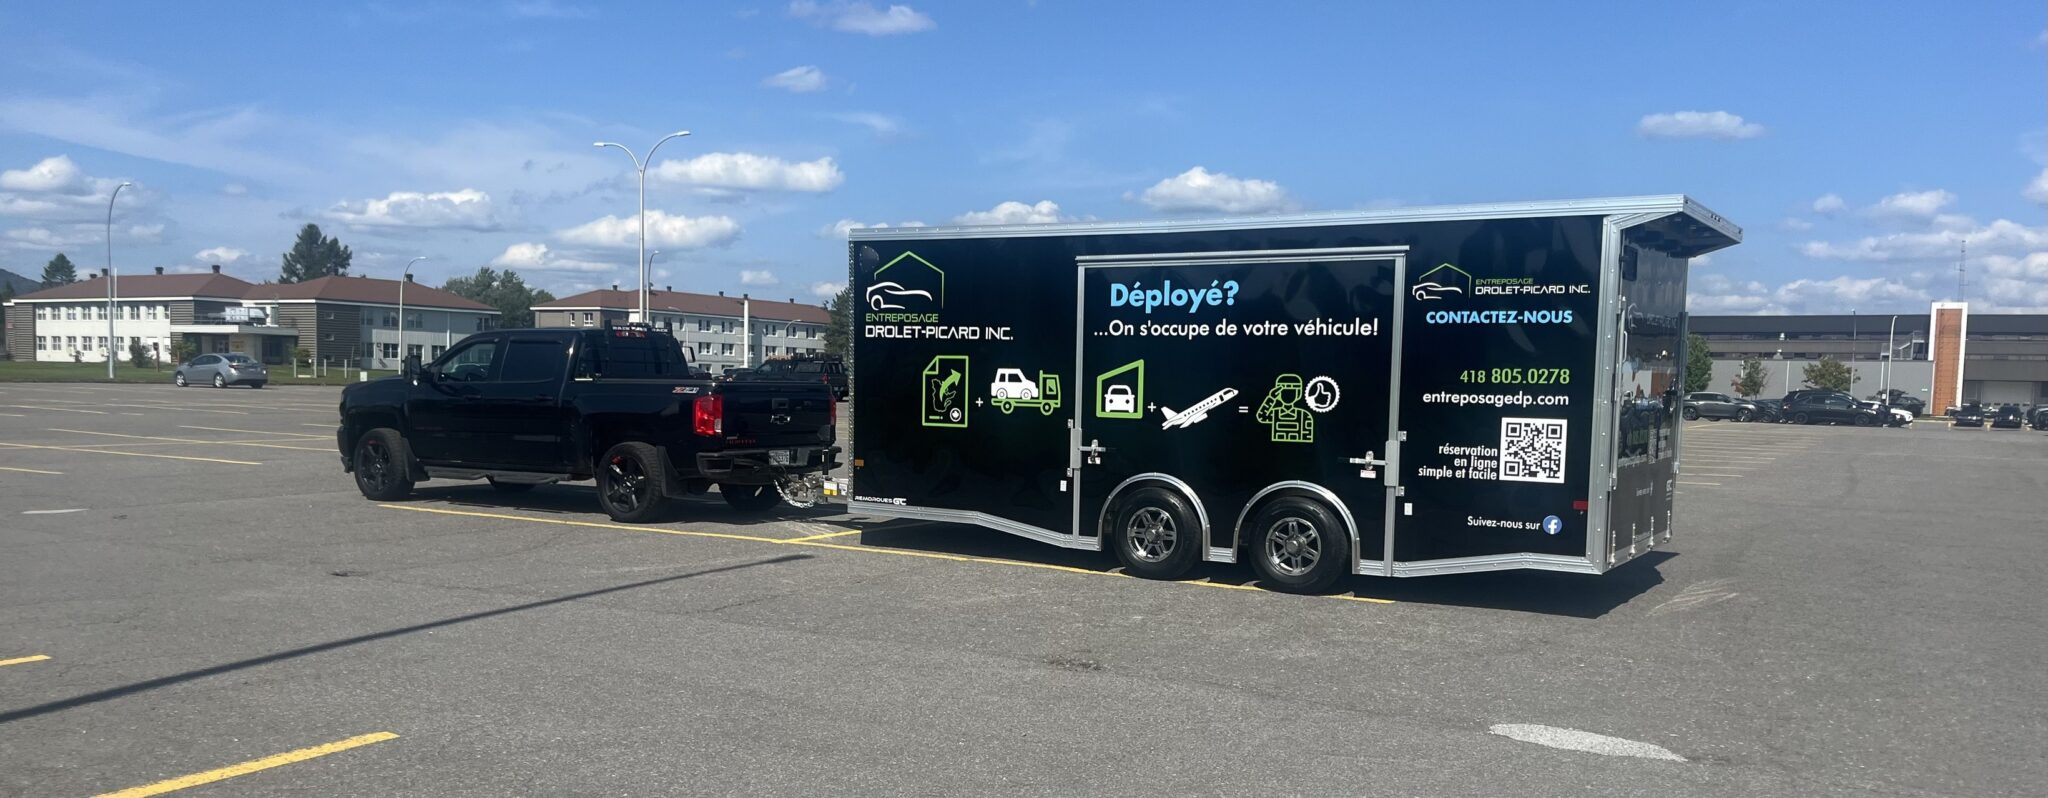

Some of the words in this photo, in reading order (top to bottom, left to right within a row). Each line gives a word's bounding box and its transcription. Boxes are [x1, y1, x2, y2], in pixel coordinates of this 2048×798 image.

[1110, 279, 1240, 314] Déployé?
[1475, 285, 1565, 295] DROLET-PICARD
[1569, 284, 1591, 294] INC.
[865, 313, 939, 323] ENTREPOSAGE
[1425, 310, 1573, 324] CONTACTEZ-NOUS
[865, 325, 980, 339] DROLET-PICARD
[985, 326, 1014, 340] INC.
[1139, 319, 1210, 340] s'occupe
[1215, 318, 1238, 336] de
[1243, 320, 1288, 336] votre
[1294, 317, 1379, 336] véhicule!
[1460, 370, 1486, 383] 418
[1491, 368, 1570, 384] 805.0278
[1422, 390, 1569, 408] entreposagedp.com
[1438, 442, 1498, 457] réservation
[1454, 458, 1467, 467] en
[1471, 455, 1498, 470] ligne
[1418, 465, 1453, 480] simple
[1455, 468, 1466, 479] et
[1468, 467, 1497, 480] facile
[893, 497, 907, 506] GC
[1467, 515, 1523, 529] Suivez-nous
[1525, 521, 1541, 530] sur
